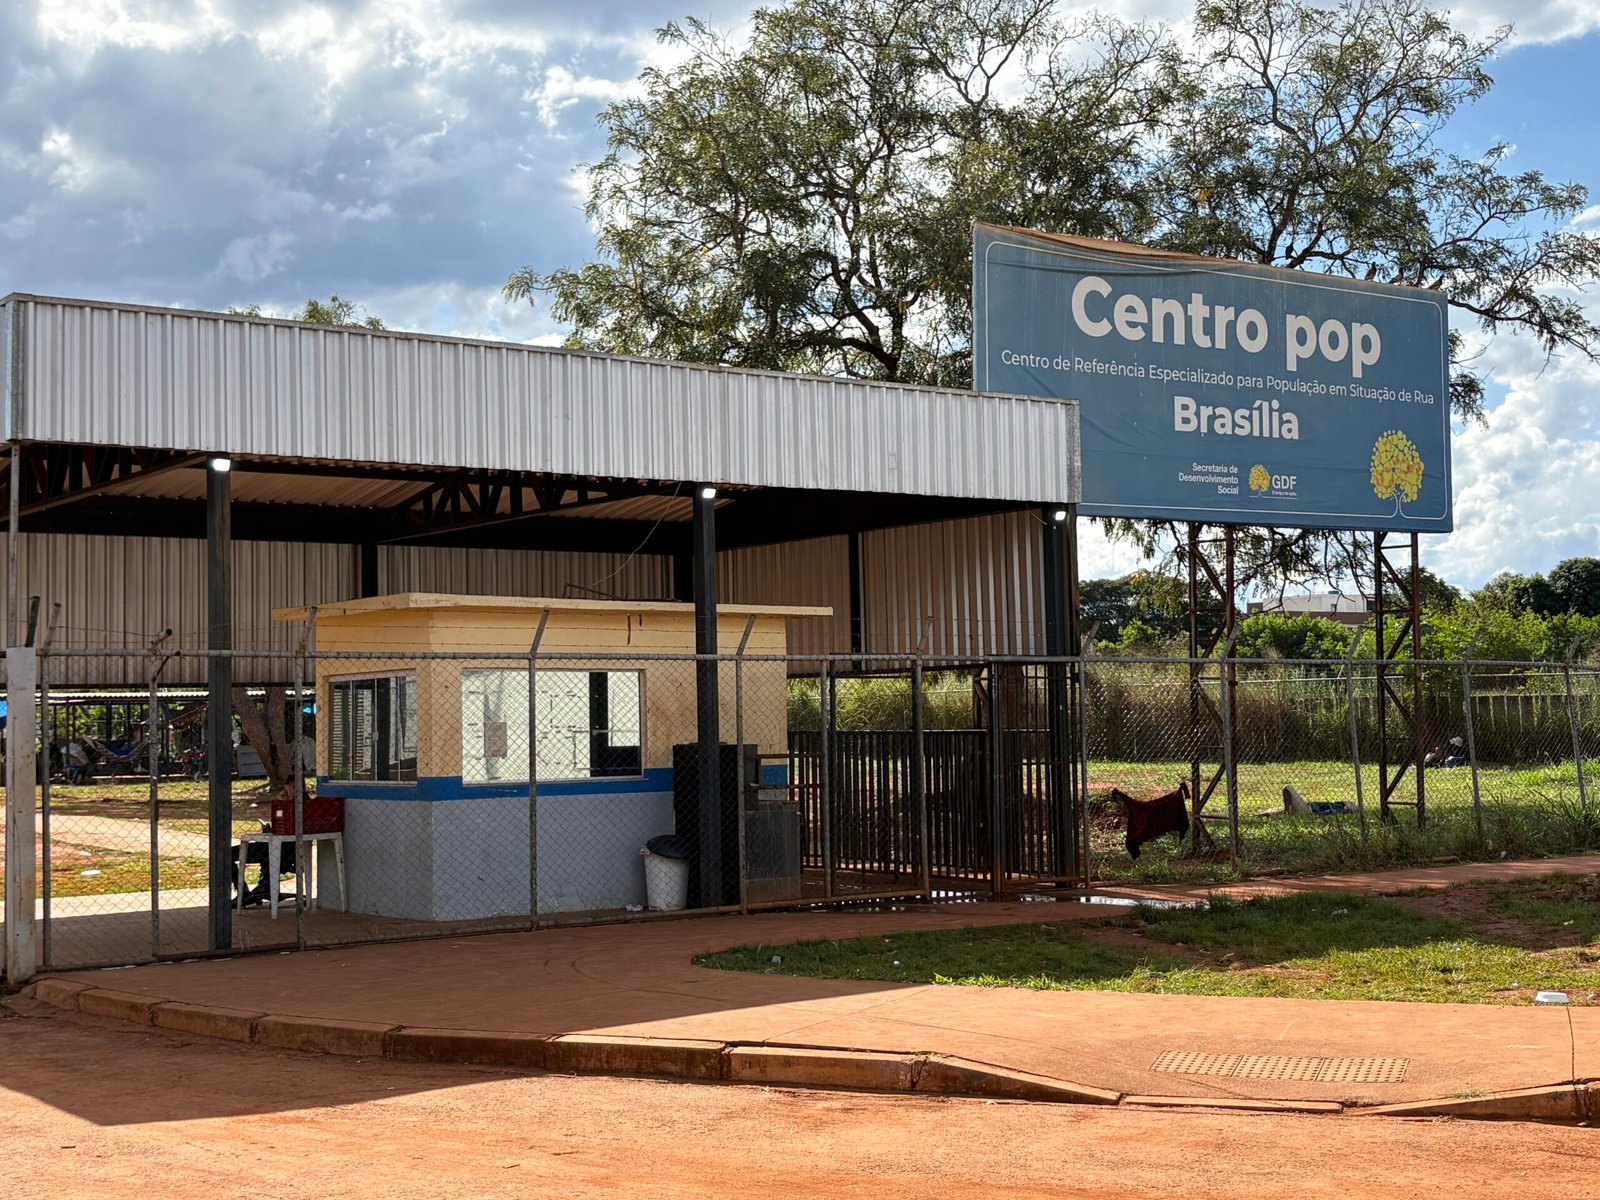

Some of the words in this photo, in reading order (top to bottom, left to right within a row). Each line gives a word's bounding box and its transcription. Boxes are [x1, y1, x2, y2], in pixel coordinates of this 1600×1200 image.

[1071, 276, 1268, 353] Centro
[1286, 313, 1381, 378] pop
[1001, 350, 1050, 369] Centro
[1053, 355, 1071, 371] de
[1074, 357, 1145, 378] Referência
[1149, 364, 1234, 386] Especializado
[1237, 374, 1263, 390] para
[1266, 375, 1327, 397] População
[1329, 384, 1347, 396] em
[1350, 384, 1395, 403] Situação
[1398, 389, 1412, 402] de
[1414, 390, 1434, 404] Rua
[1174, 395, 1299, 440] Brasília
[1192, 462, 1228, 473] Secretaria
[1229, 465, 1239, 474] de
[1178, 472, 1239, 485] Desenvolvimento
[1271, 474, 1297, 490] GDF
[1217, 485, 1239, 495] Social
